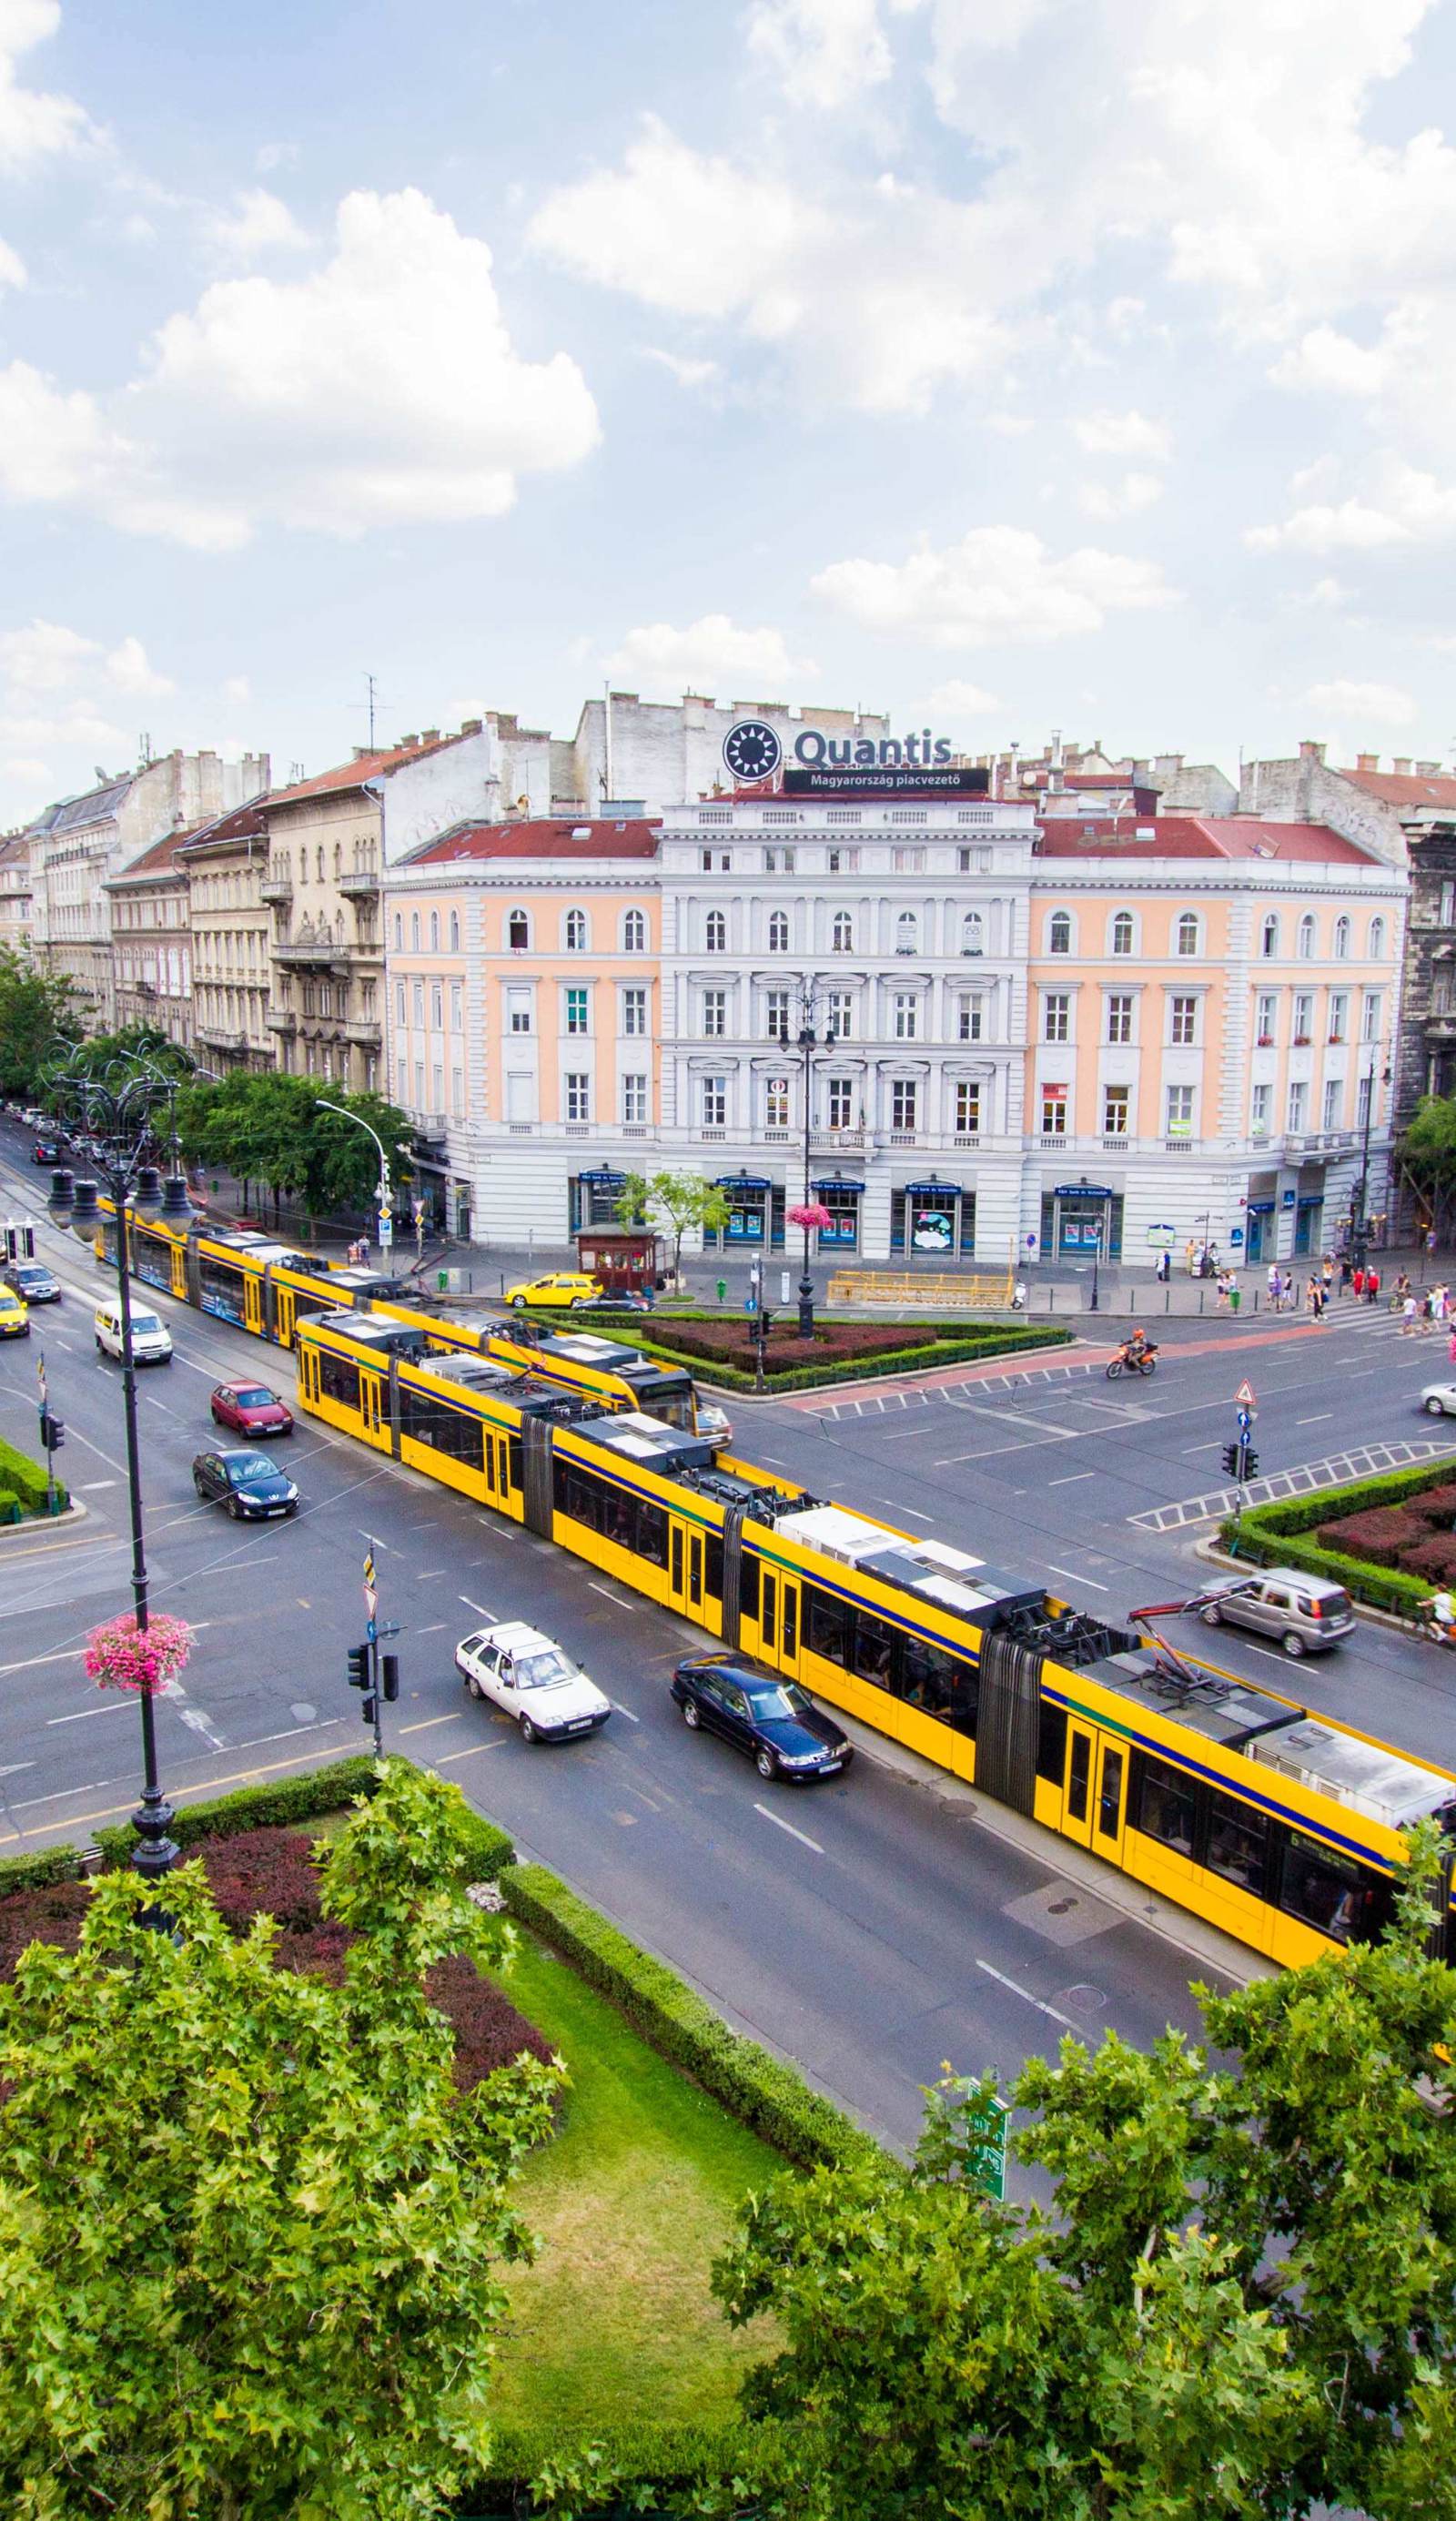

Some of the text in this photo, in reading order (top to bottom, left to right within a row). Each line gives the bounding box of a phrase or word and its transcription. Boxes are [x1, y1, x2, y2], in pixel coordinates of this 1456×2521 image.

[794, 728, 952, 770] Quantis
[811, 774, 961, 788] Magyarország piacvezető
